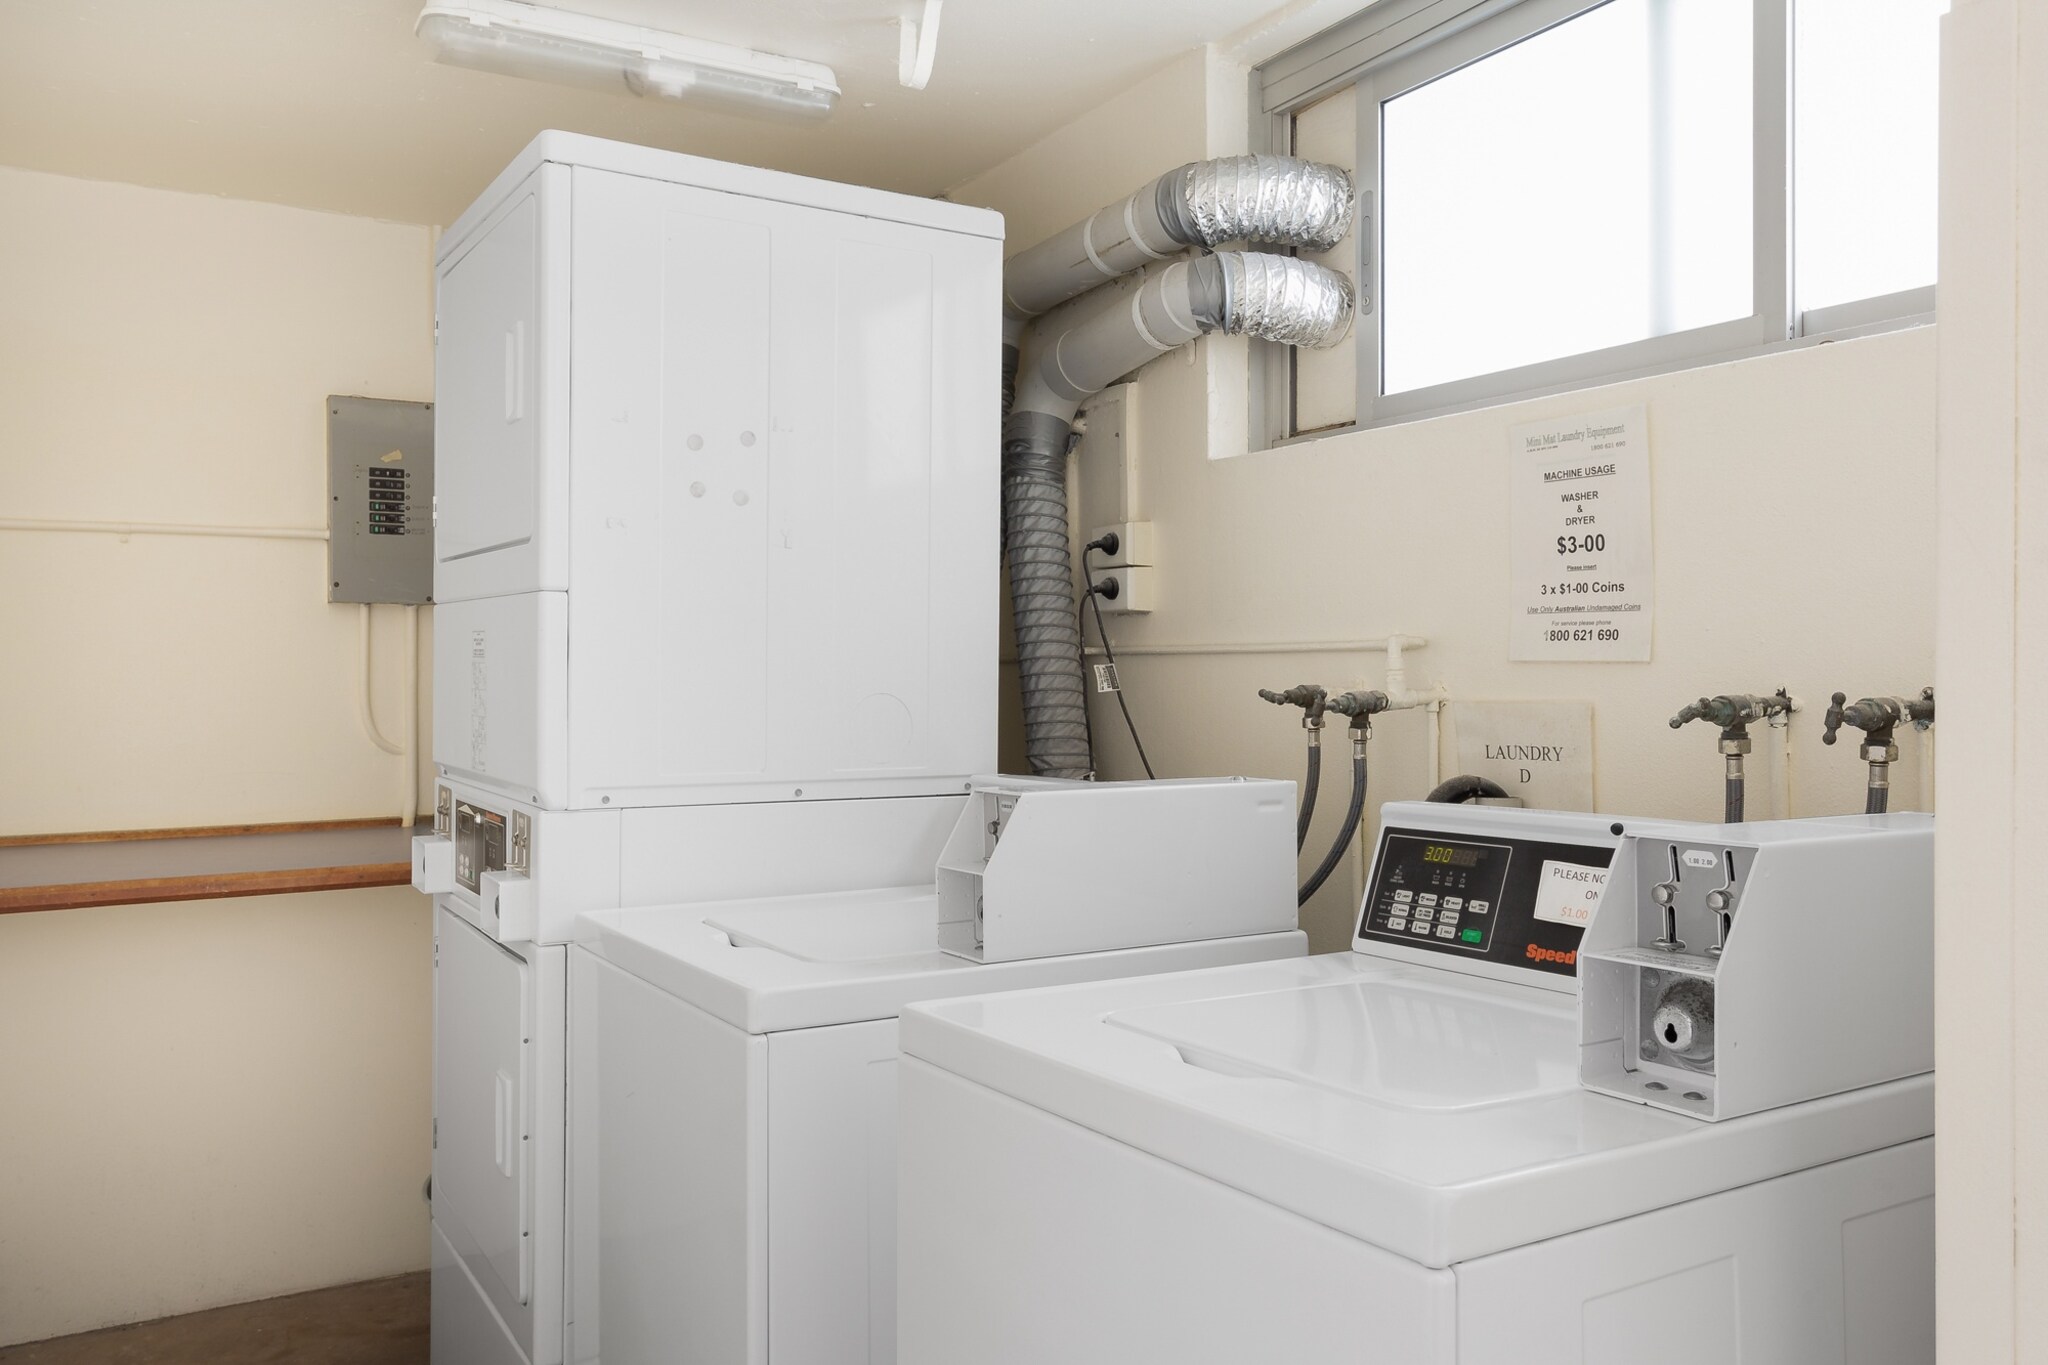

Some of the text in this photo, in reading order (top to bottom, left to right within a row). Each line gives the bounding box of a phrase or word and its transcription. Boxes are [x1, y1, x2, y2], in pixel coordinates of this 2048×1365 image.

[1526, 424, 1625, 448] Mini Mat Laundry Equipment
[1616, 440, 1626, 448] 690
[1544, 464, 1616, 481] MACHINE USAGE
[1561, 490, 1599, 502] WASHER
[1576, 504, 1583, 513] &
[1565, 515, 1595, 526] DRYER
[1557, 533, 1605, 556] $3-00
[1541, 581, 1625, 595] 3 x $1-00 Coins
[1527, 603, 1641, 614] Use Only Australian Undamaged Coins
[1596, 619, 1611, 627] phone
[1544, 629, 1619, 641] 1800 621 690
[1485, 744, 1564, 762] LAUNDRY
[1519, 768, 1531, 784] D
[1553, 867, 1590, 882] PLEASE
[1560, 906, 1588, 920] $1.00
[1526, 943, 1577, 965] Speed
